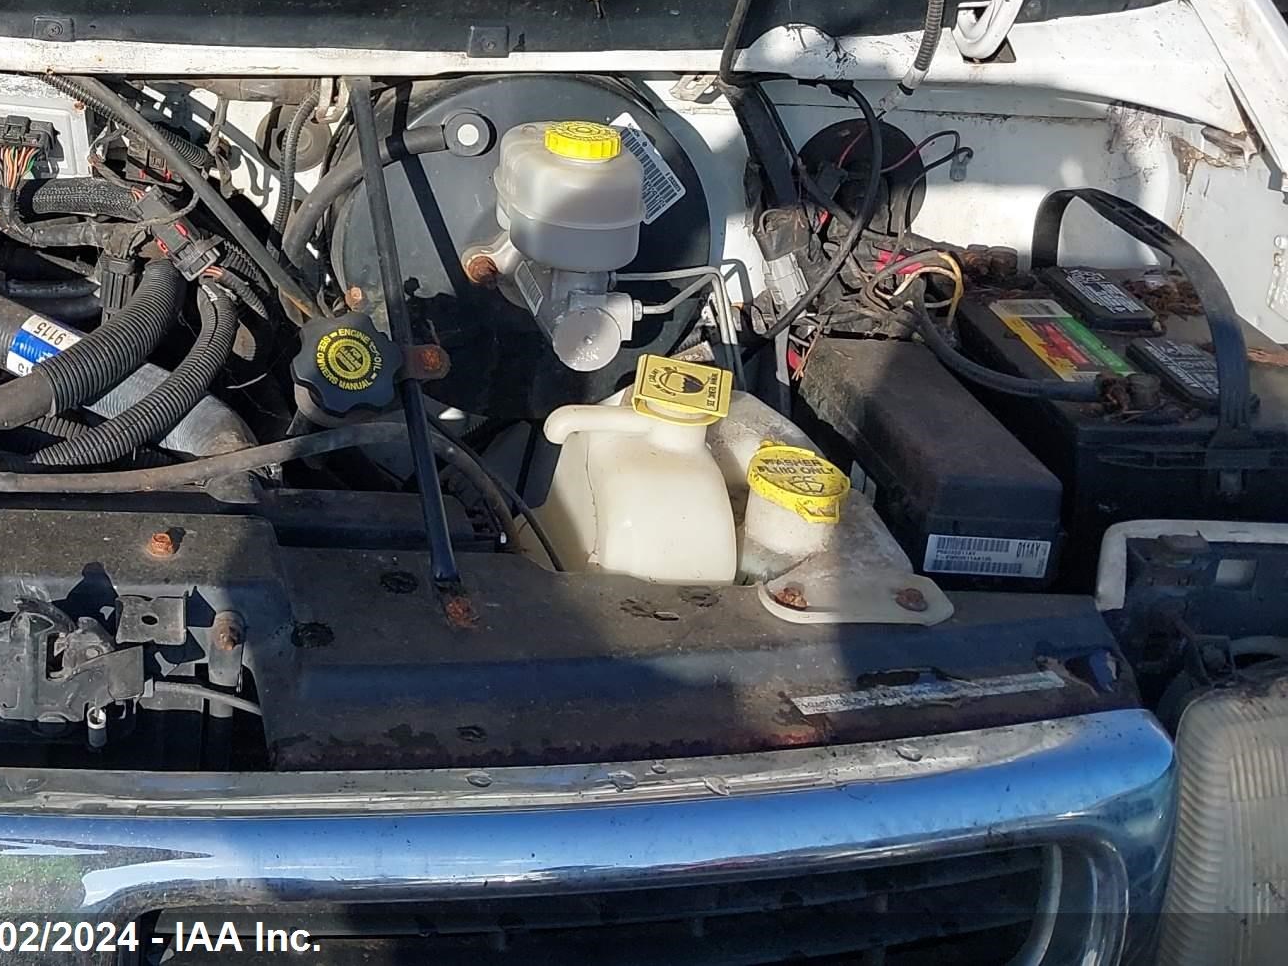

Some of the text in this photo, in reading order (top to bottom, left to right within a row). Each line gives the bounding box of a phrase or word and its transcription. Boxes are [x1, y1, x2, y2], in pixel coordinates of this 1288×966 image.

[33, 322, 67, 346] 9115
[338, 328, 371, 345] ENGINE
[317, 335, 332, 352] SEE
[338, 378, 373, 391] MANUAL
[373, 356, 383, 370] OIL
[757, 465, 834, 475] FLUID ONLY
[759, 458, 823, 467] WASHER
